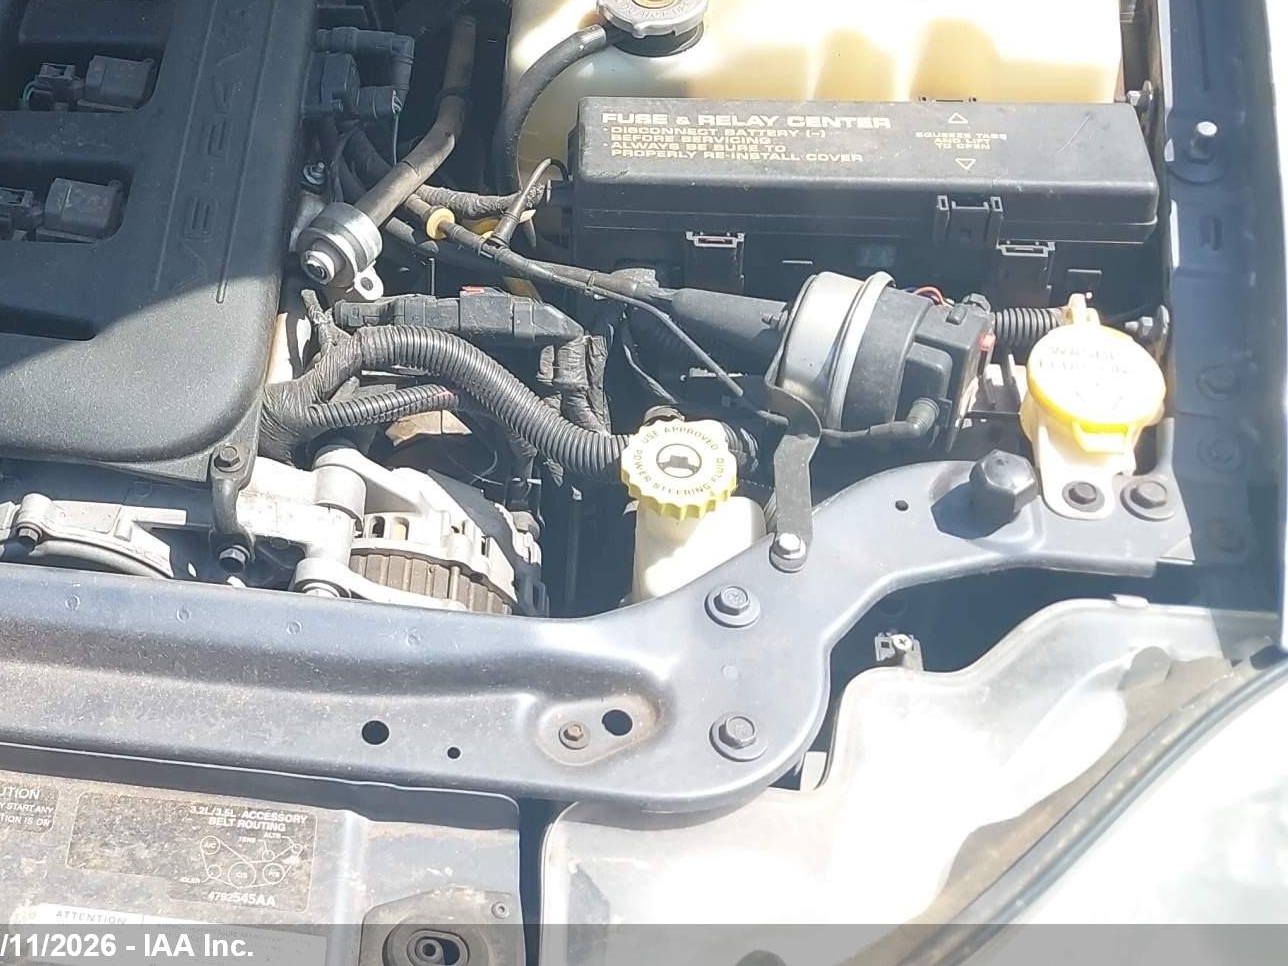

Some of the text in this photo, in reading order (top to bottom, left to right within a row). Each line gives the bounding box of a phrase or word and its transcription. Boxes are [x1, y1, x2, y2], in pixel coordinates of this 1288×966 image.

[602, 113, 892, 129] FUSE & RELAY CENTER
[611, 126, 717, 136] DISCONNECT
[725, 129, 800, 138] BATTERY
[612, 134, 771, 145] BEFORE SERVICING
[611, 141, 786, 153] ALWAYS BE SURE TO
[611, 149, 864, 162] PROPERLY RE-INSTALL COVER
[641, 426, 719, 450] USE APPROVED
[634, 449, 652, 482] POWER
[711, 457, 725, 483] FLUID
[6, 802, 36, 811] START
[34, 805, 54, 814] ANY
[23, 817, 34, 825] IS
[36, 818, 50, 827] ON
[240, 810, 309, 824] ACCESSORY
[208, 817, 286, 832] BELT ROUTING
[55, 910, 127, 926] ATTENTION
